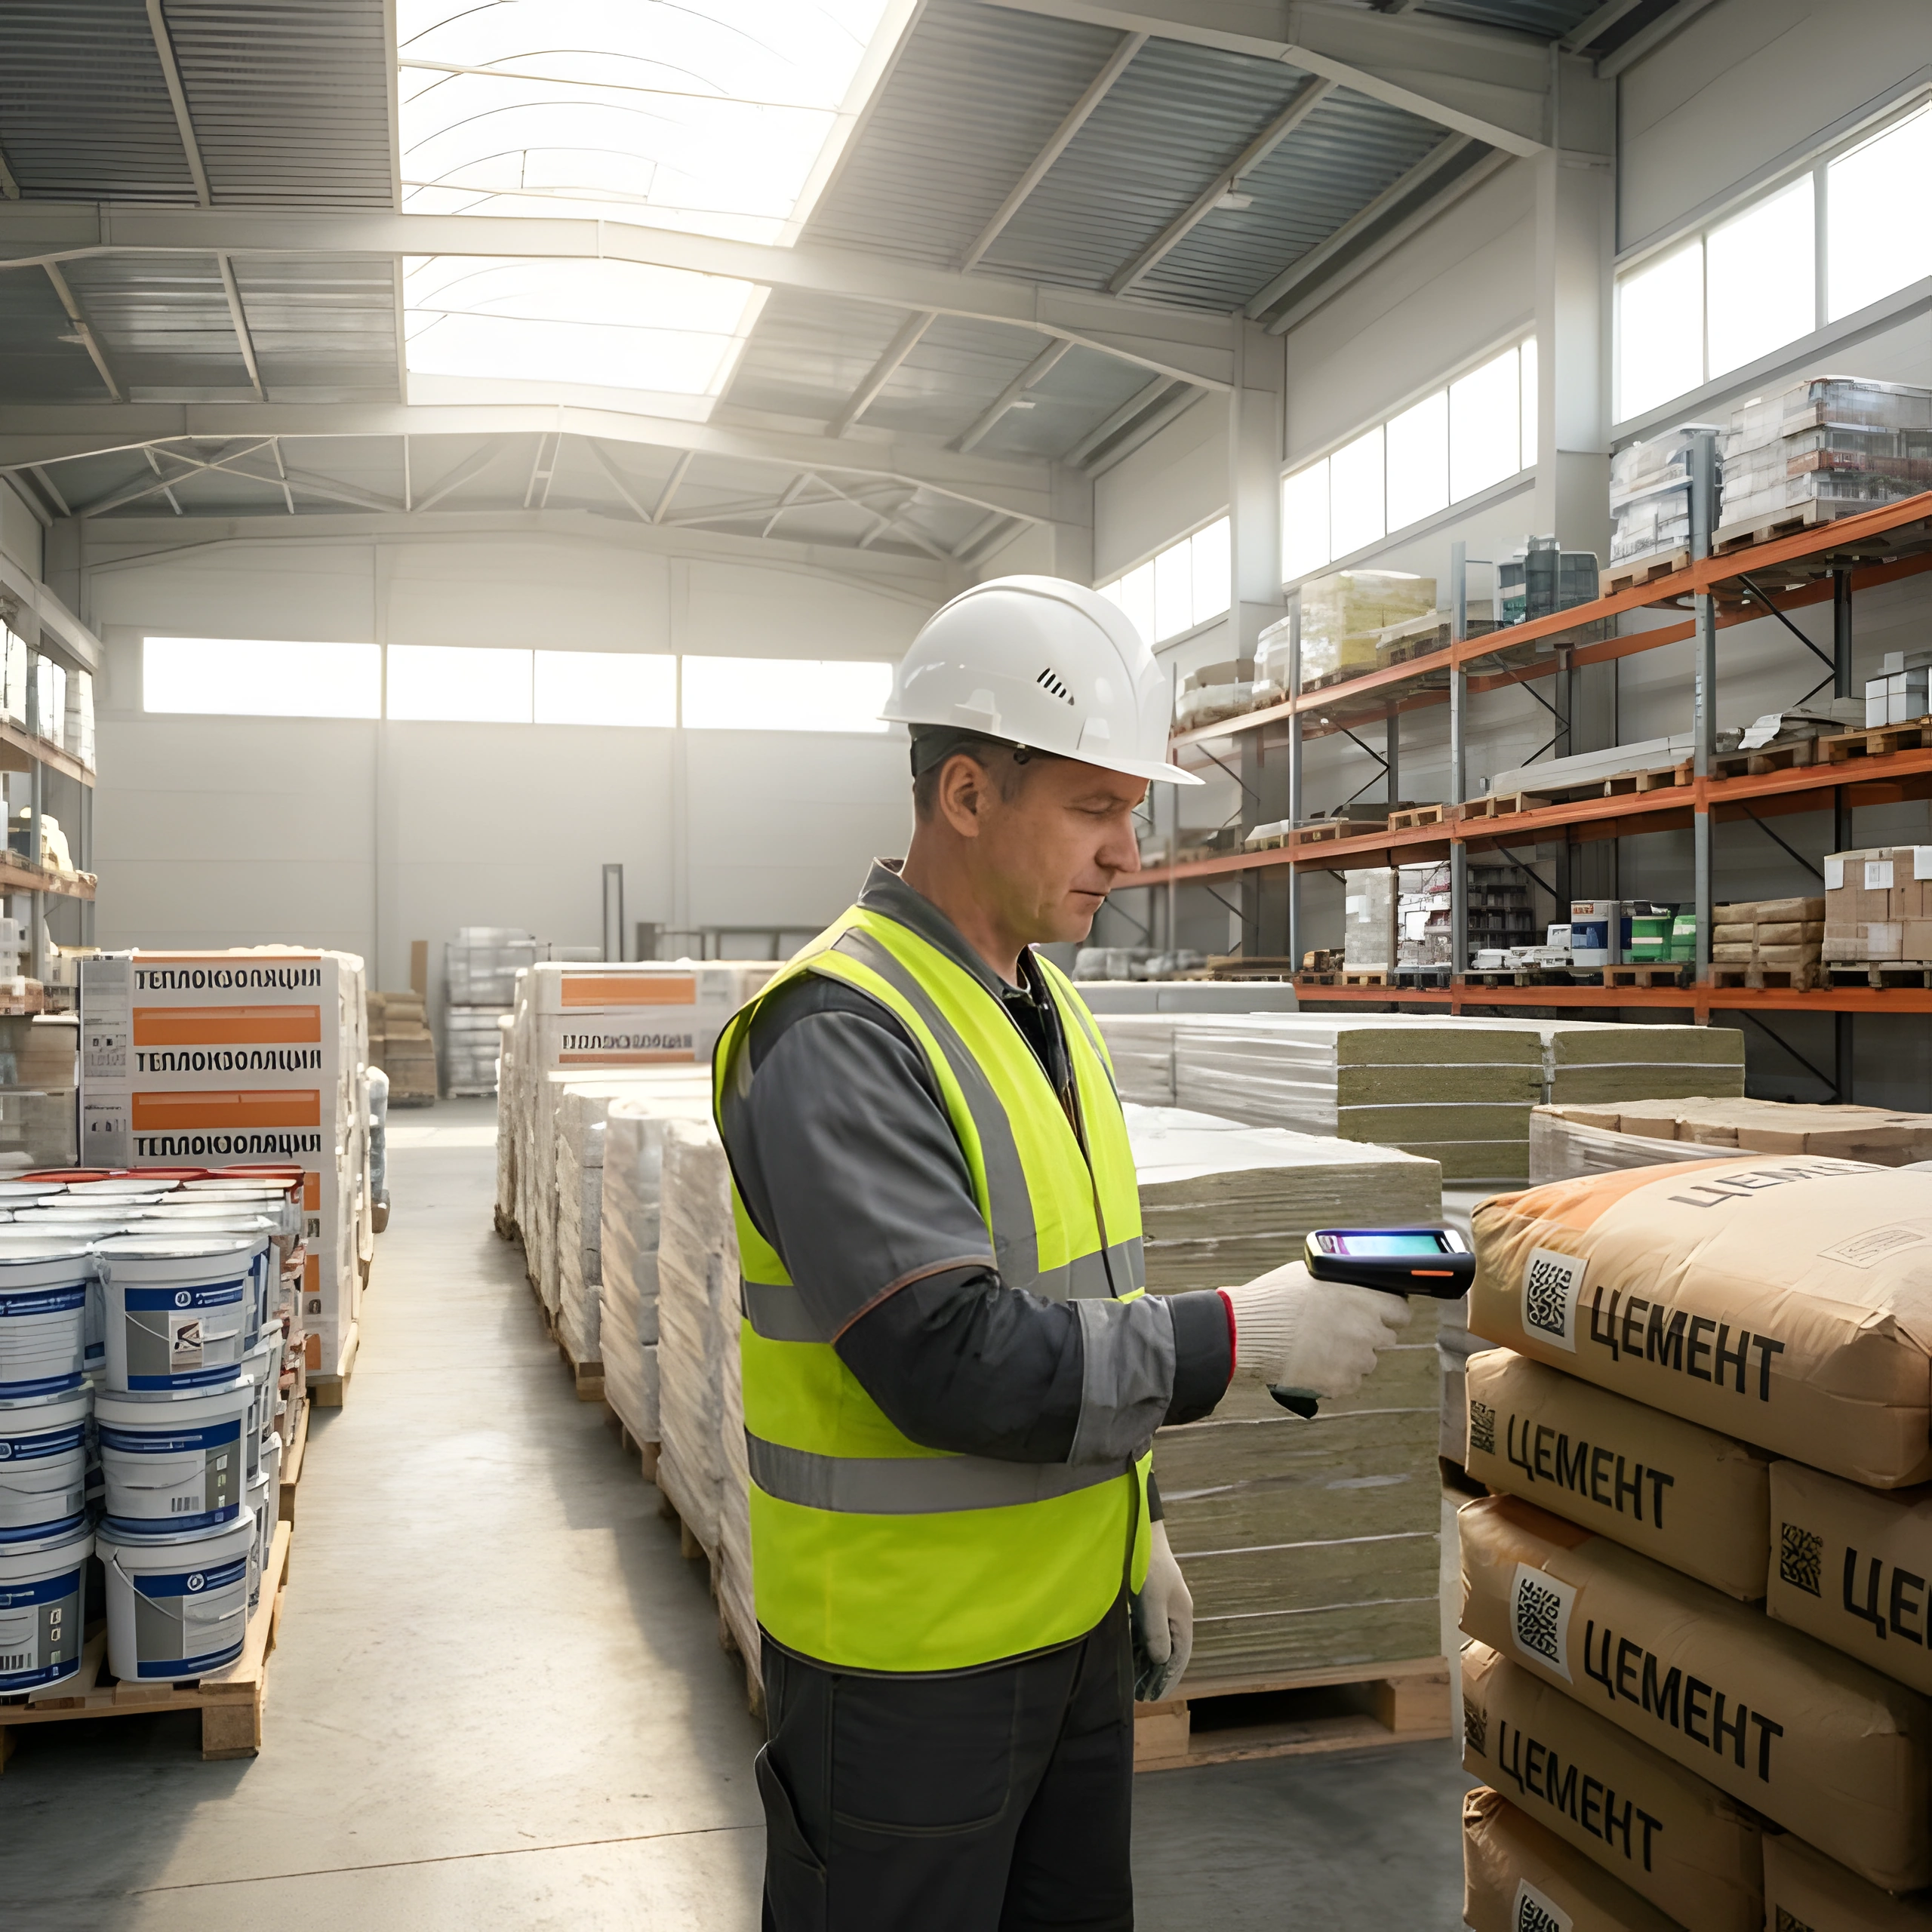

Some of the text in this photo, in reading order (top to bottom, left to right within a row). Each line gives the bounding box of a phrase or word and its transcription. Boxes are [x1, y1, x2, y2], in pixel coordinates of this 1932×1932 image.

[1667, 1162, 1891, 1208] ЦЕМ
[1589, 1285, 1786, 1403] ЦЕМЕНТ
[1506, 1413, 1675, 1530] ЦЕМЕНТ
[1843, 1546, 1932, 1651] ЦЕ
[1583, 1619, 1784, 1784] ЦЕМЕНТ
[1499, 1720, 1663, 1873] ЦЕМЕНТ
